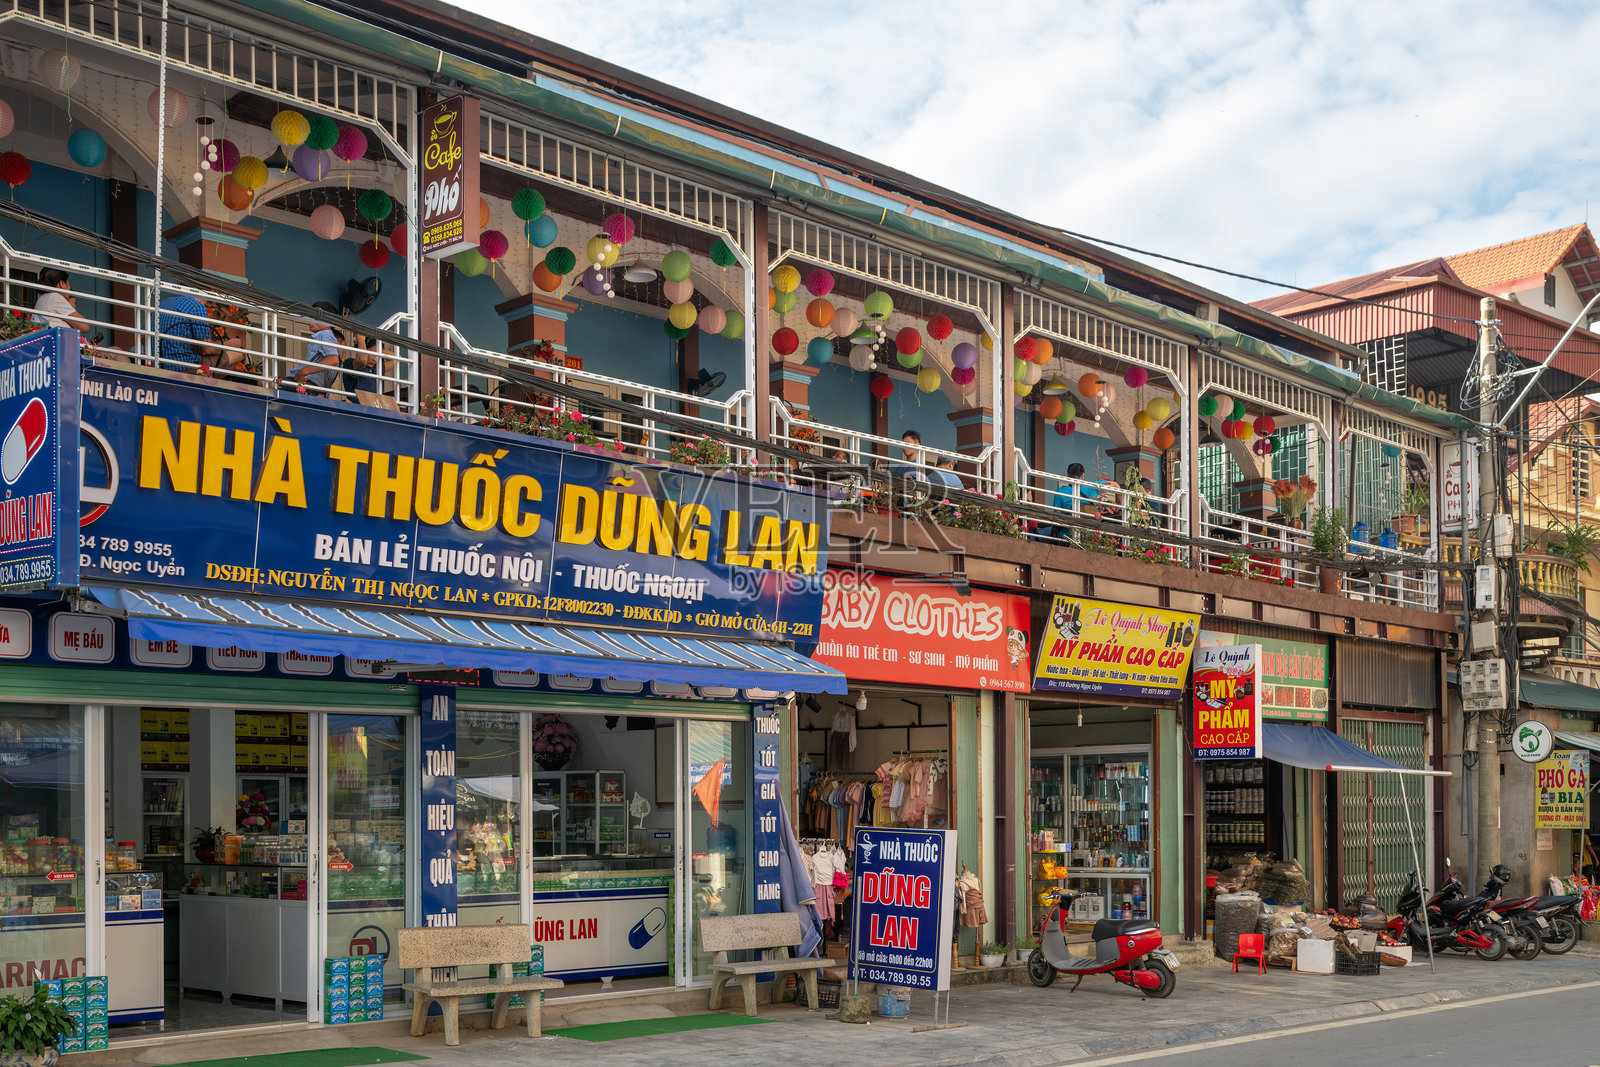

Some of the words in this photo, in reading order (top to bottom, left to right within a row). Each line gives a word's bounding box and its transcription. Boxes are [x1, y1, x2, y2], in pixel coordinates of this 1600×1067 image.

[425, 131, 461, 171] Cafe
[425, 164, 461, 220] Phố
[18, 346, 51, 395] THUỐC
[106, 381, 132, 402] LÀO
[136, 389, 158, 406] CAI
[137, 415, 307, 508] NHÀ
[326, 444, 543, 537] THUỐC
[557, 476, 711, 562] DŨNG
[720, 509, 821, 576] LAN
[29, 492, 52, 541] LAN
[100, 537, 129, 552] 789
[134, 540, 172, 557] 9955
[100, 556, 141, 575] Ngọc
[147, 557, 185, 578] Uyển
[314, 531, 372, 565] BÁN
[378, 534, 410, 569] LẺ
[417, 543, 496, 578] THUỐC
[501, 552, 543, 587] NỘI
[572, 563, 641, 594] THUỐC
[643, 573, 706, 604] NGOẠI
[205, 563, 265, 584] DSĐH:
[267, 567, 346, 592] NGUYỄN
[352, 578, 385, 600] THỊ
[390, 582, 440, 603] NGỌC
[444, 586, 477, 603] LAN
[695, 609, 720, 628] GIỜ
[721, 612, 743, 630] MỞ
[821, 583, 880, 629] BABY
[883, 591, 1003, 641] CLOTHES
[1084, 608, 1107, 628] Lê
[1141, 614, 1169, 640] Shop
[64, 631, 79, 650] MẸ
[1049, 636, 1079, 659] MỸ
[1077, 634, 1125, 664] PHẨM
[1125, 646, 1156, 667] CAO
[1158, 642, 1186, 669] CẤP
[846, 642, 859, 658] ÁO
[863, 644, 880, 661] TRẺ
[883, 648, 898, 662] EM
[909, 650, 922, 664] SƠ
[924, 652, 945, 666] SINH
[1199, 651, 1215, 664] Lê
[989, 679, 1002, 687] 0964
[1210, 675, 1237, 699] MỸ
[431, 695, 448, 721] AN
[1199, 702, 1250, 729] PHẨM
[756, 712, 780, 734] THUỐC
[1200, 734, 1224, 744] CAO
[1227, 730, 1250, 744] CẤP
[426, 744, 455, 777] TOÀN
[760, 745, 776, 767] TỐT
[1198, 749, 1208, 757] ĐT:
[1210, 748, 1225, 756] 0975
[1226, 748, 1237, 756] 854
[1538, 761, 1564, 788] PHỞ
[1568, 763, 1585, 788] GÀ
[760, 779, 776, 800] GIÁ
[1558, 792, 1584, 804] BIA
[427, 798, 454, 836] HIỆU
[759, 811, 777, 833] TỐT
[758, 850, 779, 867] GIAO
[879, 838, 900, 861] NHÀ
[904, 837, 938, 863] THUỐC
[429, 850, 453, 887] QUẢ
[757, 880, 780, 901] HÀNG
[862, 867, 931, 909] DŨNG
[534, 916, 564, 942] ŨNG
[569, 917, 598, 940] LAN
[870, 914, 919, 950] LAN
[889, 953, 902, 964] 6h00
[915, 957, 932, 968] 22h00
[869, 969, 931, 986] 034.789.99.55
